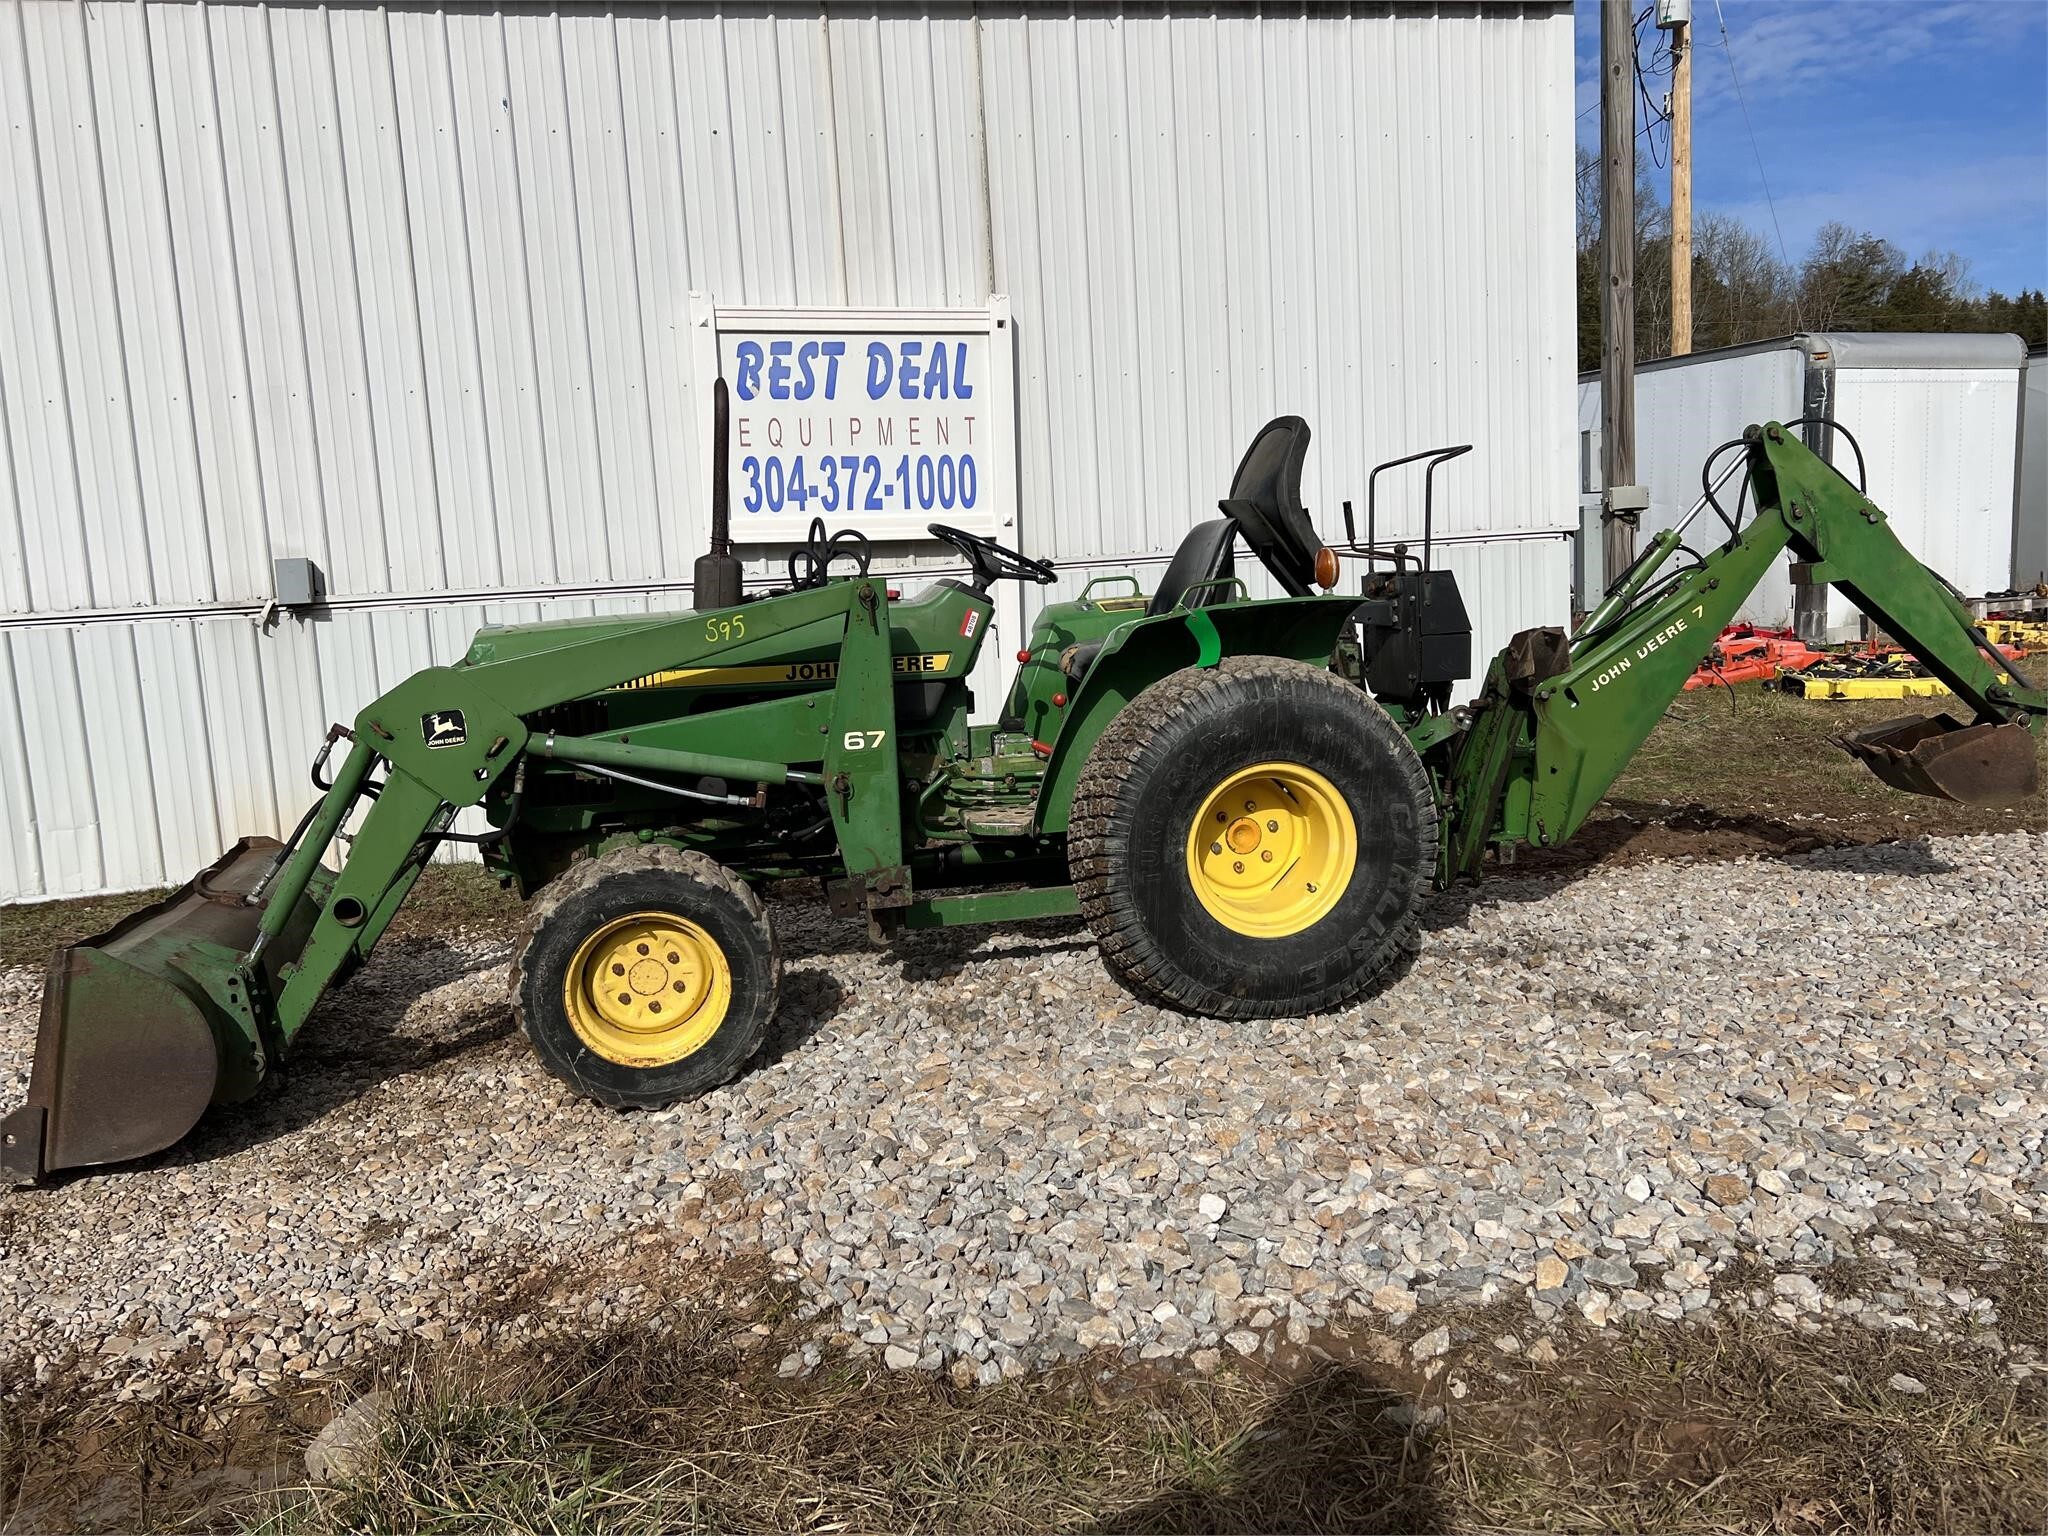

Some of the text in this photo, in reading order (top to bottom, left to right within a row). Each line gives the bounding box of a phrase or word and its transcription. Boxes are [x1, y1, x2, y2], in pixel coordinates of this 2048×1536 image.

[736, 341, 973, 400] BEST DEAL
[738, 416, 975, 448] EQUIPMENT
[742, 454, 977, 513] 304-372-1000
[1691, 605, 1704, 619] 7
[893, 656, 934, 672] ERE
[1592, 658, 1632, 692] JOHN
[844, 730, 886, 750] 67
